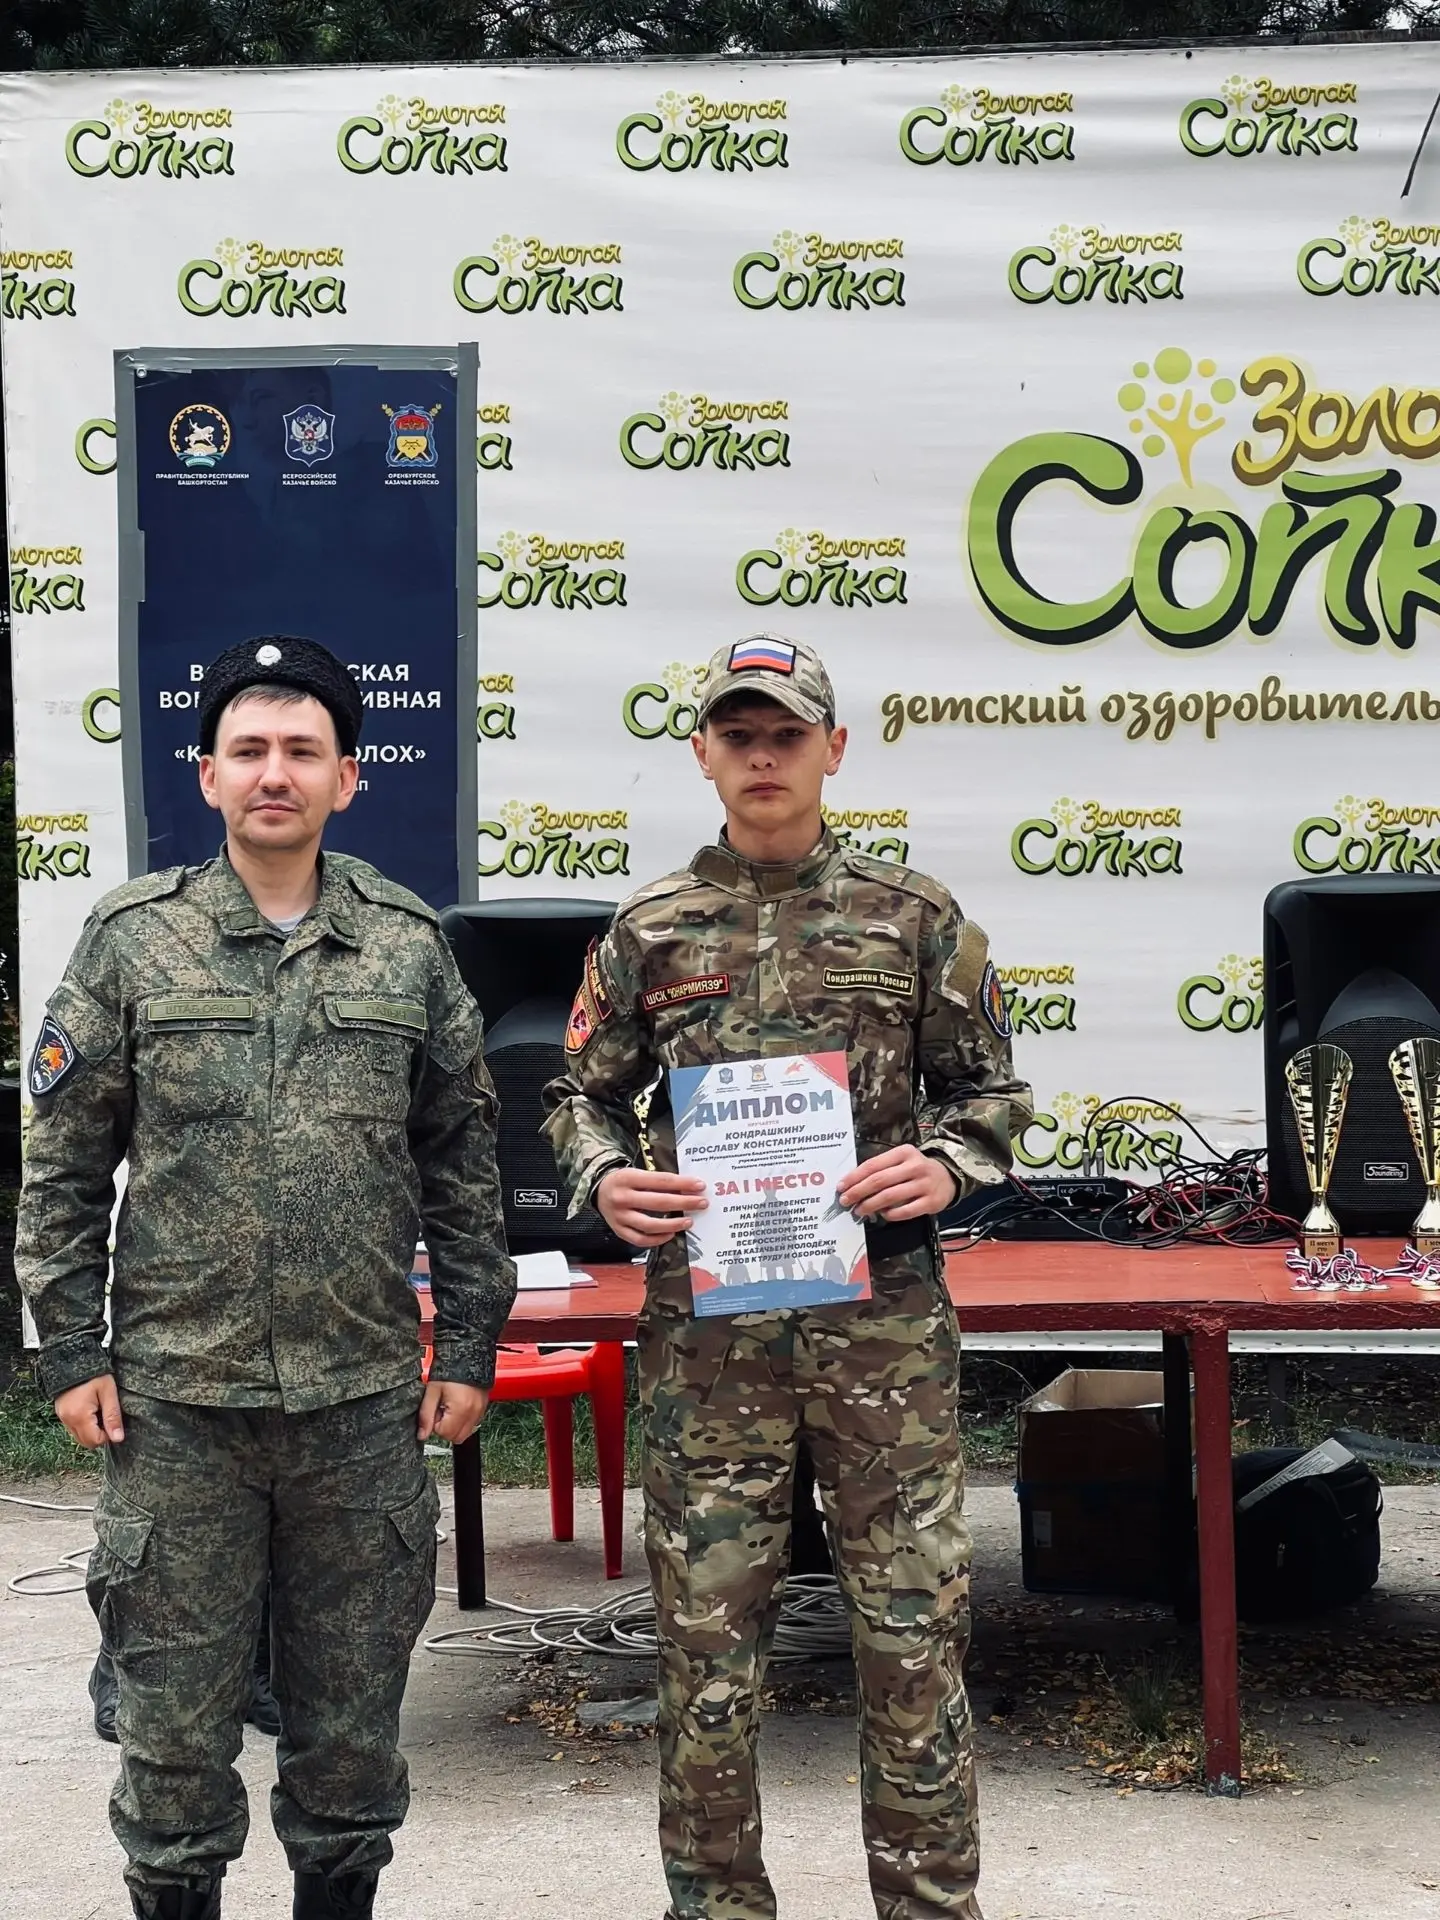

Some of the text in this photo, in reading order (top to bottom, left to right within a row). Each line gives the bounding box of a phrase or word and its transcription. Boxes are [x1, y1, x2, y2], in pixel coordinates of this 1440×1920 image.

[972, 87, 1073, 121] Золотая
[1252, 78, 1357, 109] Золотая
[135, 102, 232, 132] Золотая
[409, 98, 505, 130] Золотая
[688, 95, 787, 125] Золотая
[245, 242, 343, 271] Золотая
[524, 238, 621, 270] Золотая
[804, 235, 903, 265] Золотая
[1080, 229, 1182, 261] Золотая
[0, 250, 73, 272] лотая
[1297, 238, 1440, 297] Сопк
[688, 395, 788, 427] Золотая
[12, 546, 82, 568] лотая
[527, 533, 625, 566] Золотая
[807, 531, 905, 563] Золотая
[881, 685, 1087, 743] детский
[529, 803, 628, 833] Золотая
[1081, 801, 1181, 833] Золотая
[1293, 817, 1440, 874] Сопк
[825, 971, 910, 988] Кондрашкин Ярослав
[646, 990, 668, 1005] ШСК
[695, 1089, 834, 1127] ДИПЛОМ
[685, 1131, 848, 1155] ЯРОСЛАВУ КОНСТАНТИНОВИЧУ
[725, 1124, 806, 1140] КОНДРАШКИНУ
[714, 1180, 740, 1196] ЗА
[755, 1171, 825, 1192] МЕСТО
[729, 1202, 767, 1212] ЛИЧНОМ
[767, 1196, 821, 1208] ПЕРВЕНСТВЕ
[740, 1207, 806, 1220] НА ИСПЫТАНИИ
[736, 1232, 815, 1247] ВСЕРОССИЙСКОГО
[737, 1227, 792, 1238] ВОЙСКОВОМ
[792, 1223, 819, 1233] ЭТАПЕ
[743, 1243, 786, 1255] КАЗАЧЬЕЙ
[751, 1255, 757, 1263] К
[758, 1252, 783, 1263] ТРУДУ
[783, 1252, 791, 1260] И
